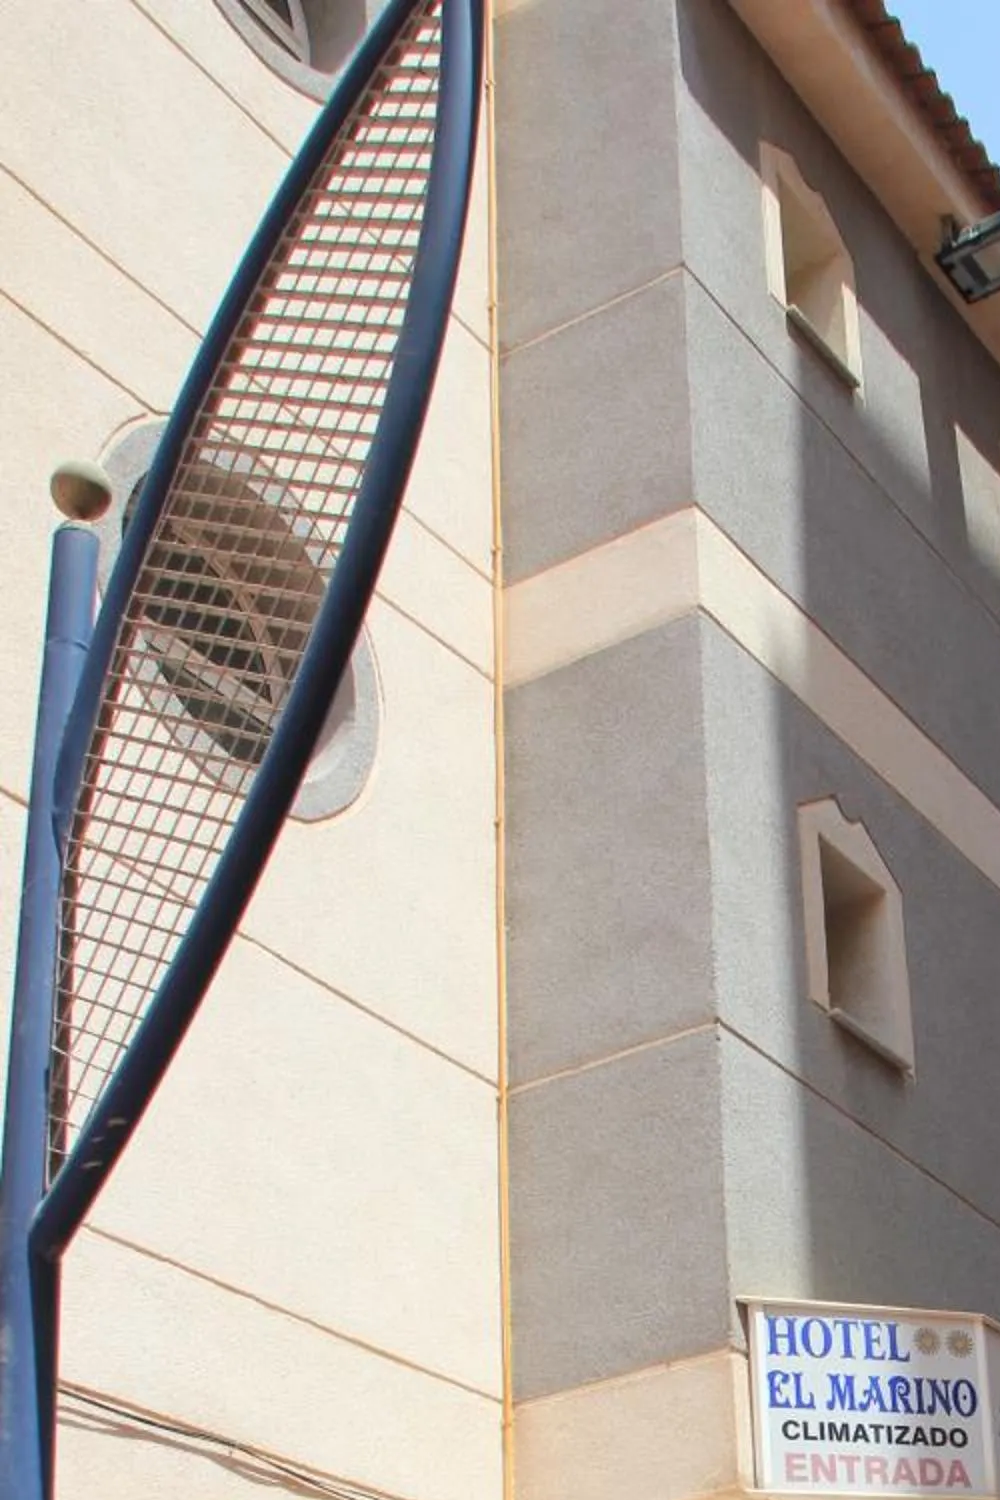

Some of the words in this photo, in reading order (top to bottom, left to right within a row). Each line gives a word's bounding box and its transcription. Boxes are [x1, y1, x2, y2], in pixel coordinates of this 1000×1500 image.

[767, 1315, 910, 1362] HOTEL
[767, 1370, 816, 1409] EL
[826, 1373, 977, 1417] MARINO
[782, 1419, 968, 1448] CLIMATIZADO
[784, 1453, 972, 1488] ENTRADA
